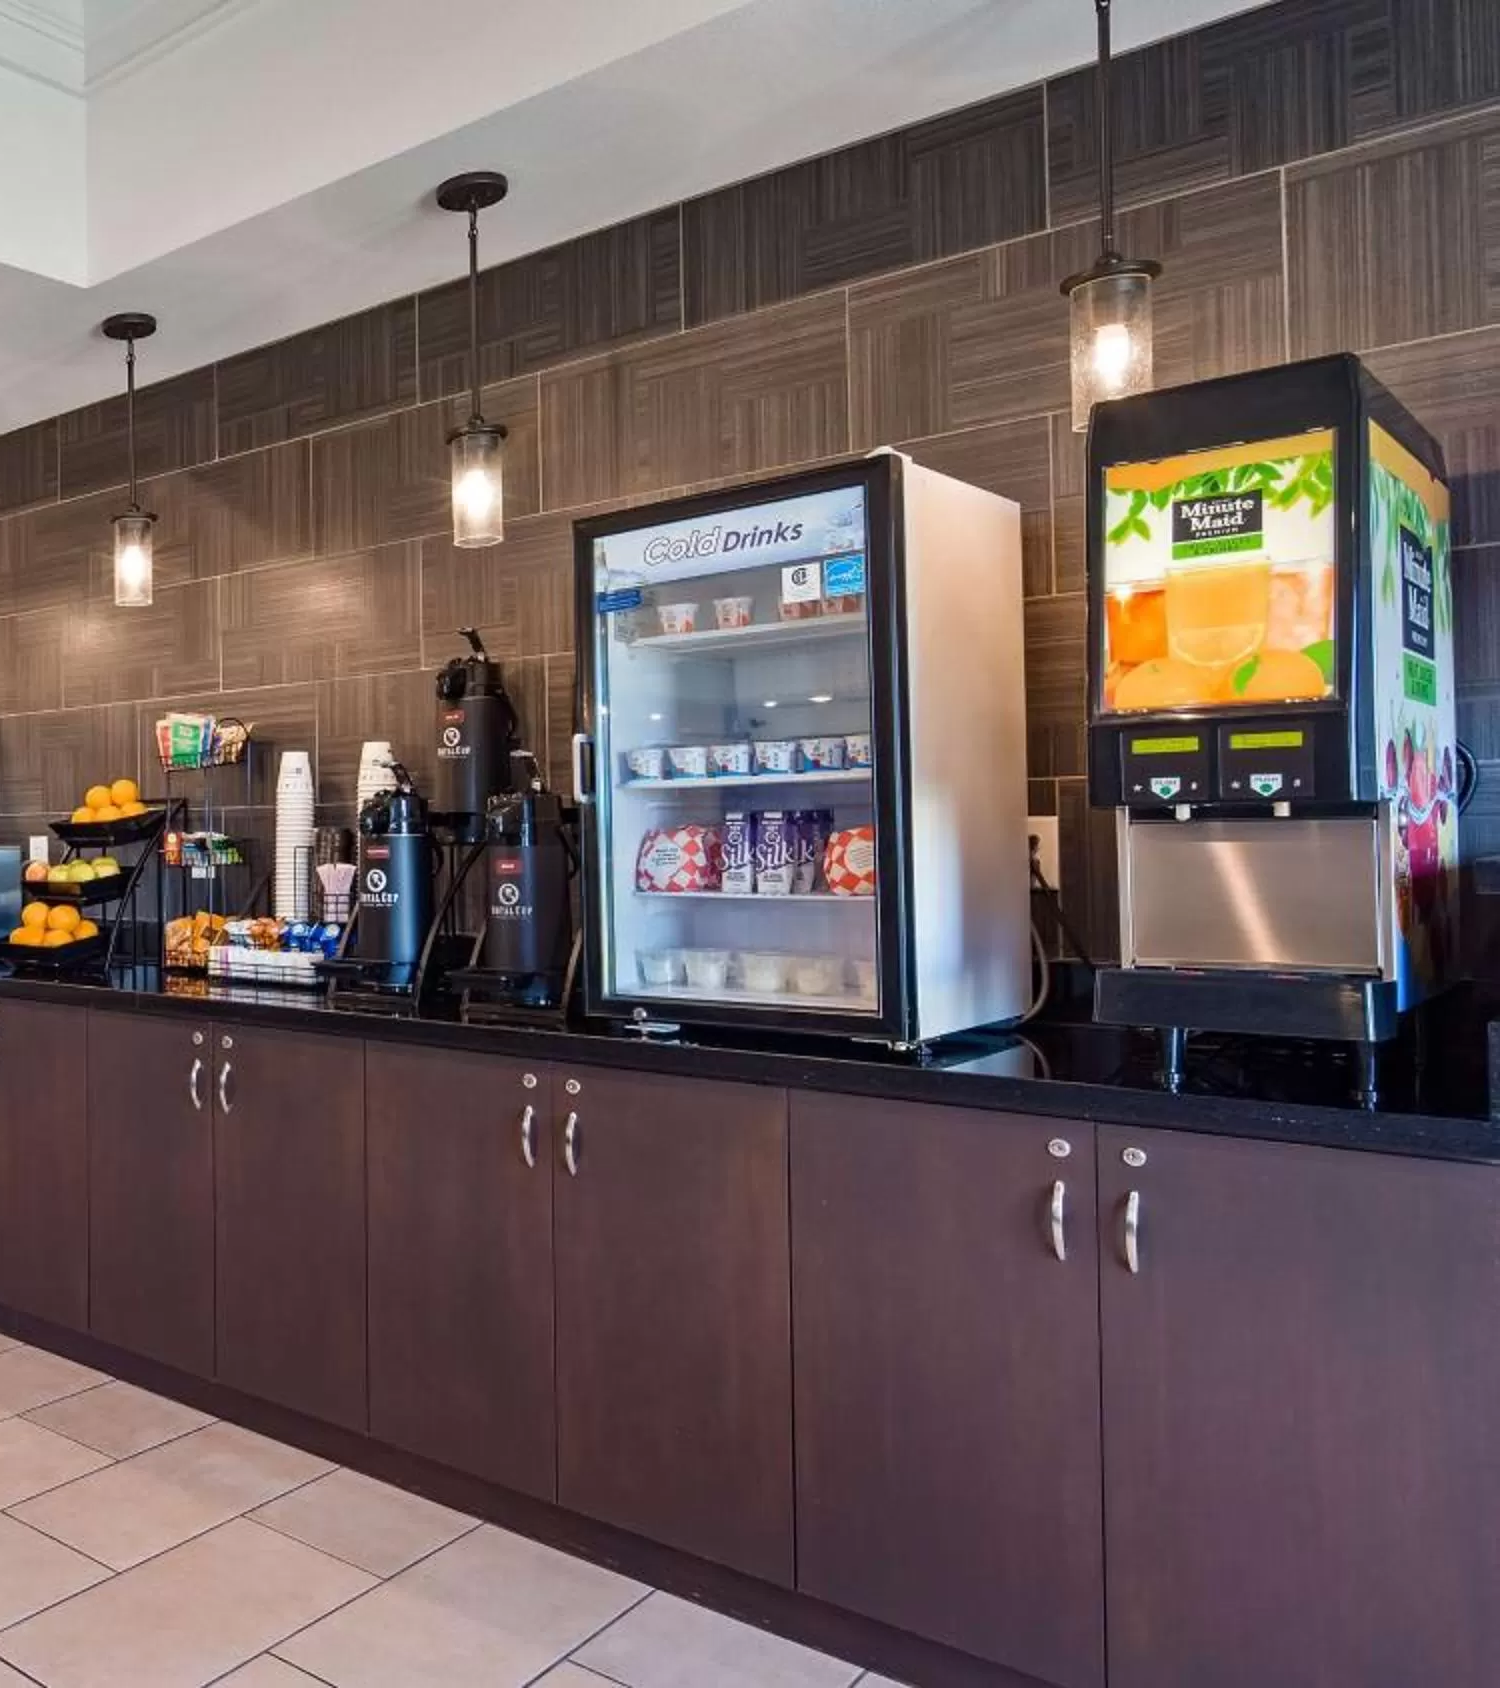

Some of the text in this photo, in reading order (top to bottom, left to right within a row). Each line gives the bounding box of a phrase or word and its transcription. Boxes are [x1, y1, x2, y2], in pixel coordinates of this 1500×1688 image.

[1180, 498, 1255, 519] Minute
[1190, 511, 1244, 531] Maid
[643, 521, 803, 566] Cold Drinks
[716, 840, 754, 872] Silk
[756, 840, 795, 872] Silk
